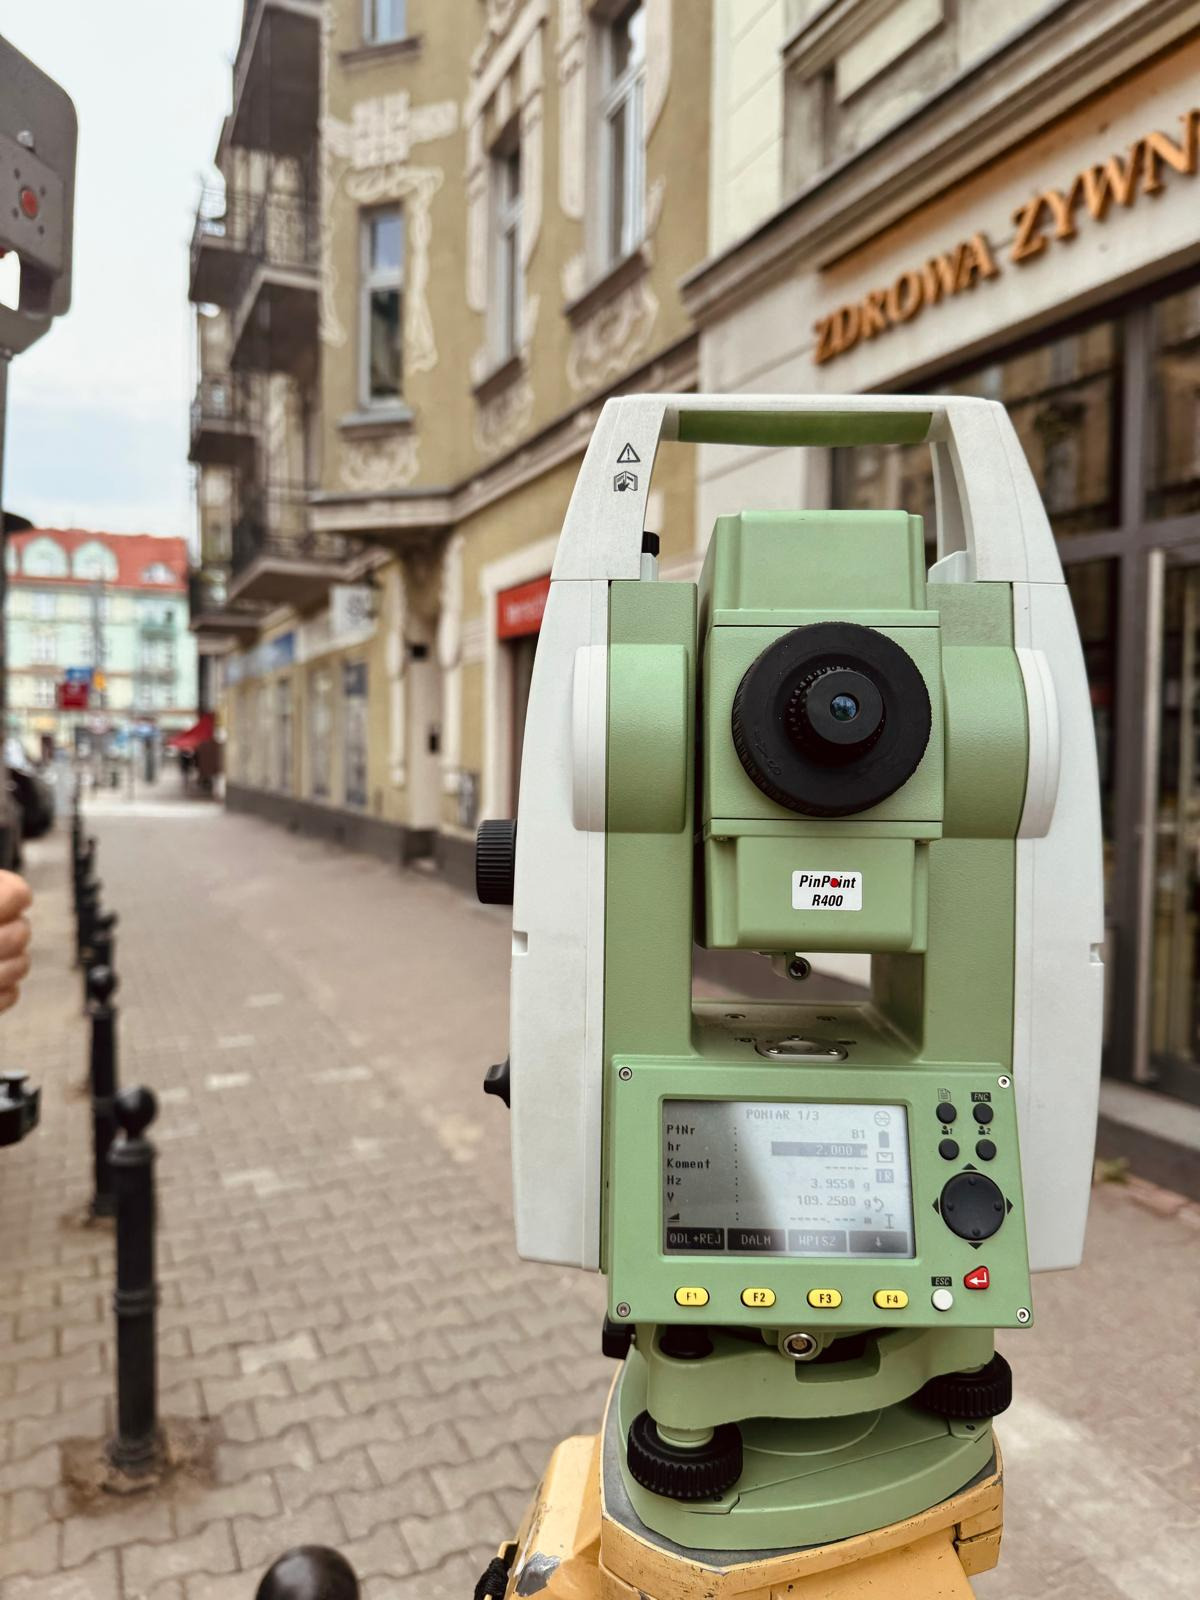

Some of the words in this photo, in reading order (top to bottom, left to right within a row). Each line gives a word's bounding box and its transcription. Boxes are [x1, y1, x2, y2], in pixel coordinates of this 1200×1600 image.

[814, 232, 999, 365] ZDROWA
[812, 894, 843, 906] R400
[798, 1110, 820, 1121] 1/3
[667, 1124, 696, 1135] PtNr
[667, 1141, 681, 1152] hr
[815, 1144, 853, 1156] 2.000
[667, 1158, 711, 1169] Koment
[667, 1175, 682, 1186] Hz
[667, 1192, 675, 1203] V
[935, 1277, 950, 1286] ESC
[686, 1291, 698, 1301] F1
[753, 1292, 766, 1302] F2
[819, 1294, 832, 1304] F3
[886, 1295, 899, 1305] F4
